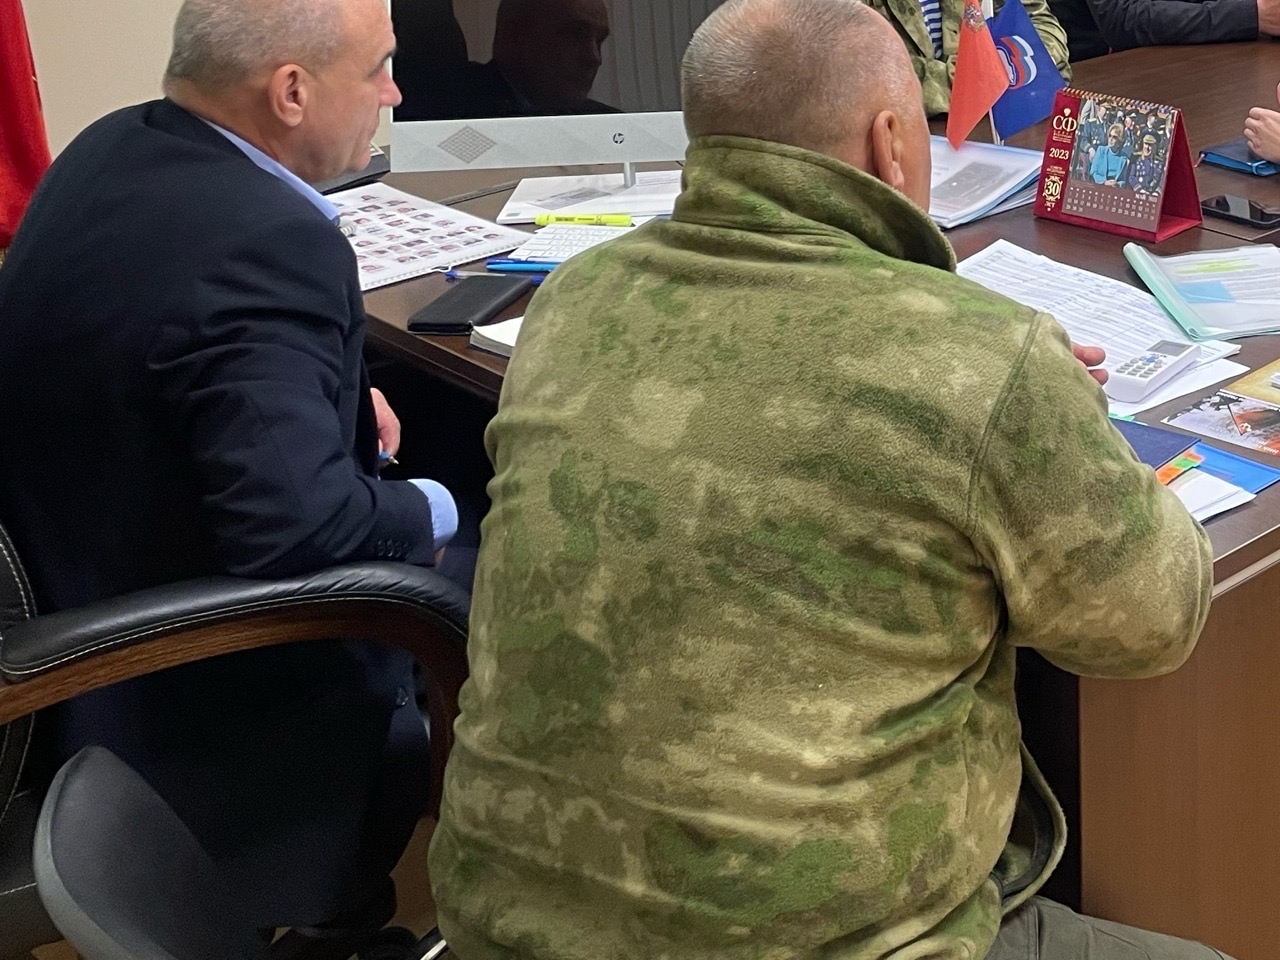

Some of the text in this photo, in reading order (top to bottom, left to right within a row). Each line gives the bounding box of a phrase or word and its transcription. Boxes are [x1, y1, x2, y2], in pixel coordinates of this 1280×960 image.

[1053, 115, 1076, 131] СФ
[1049, 148, 1069, 160] 2023
[1046, 182, 1060, 196] 30
